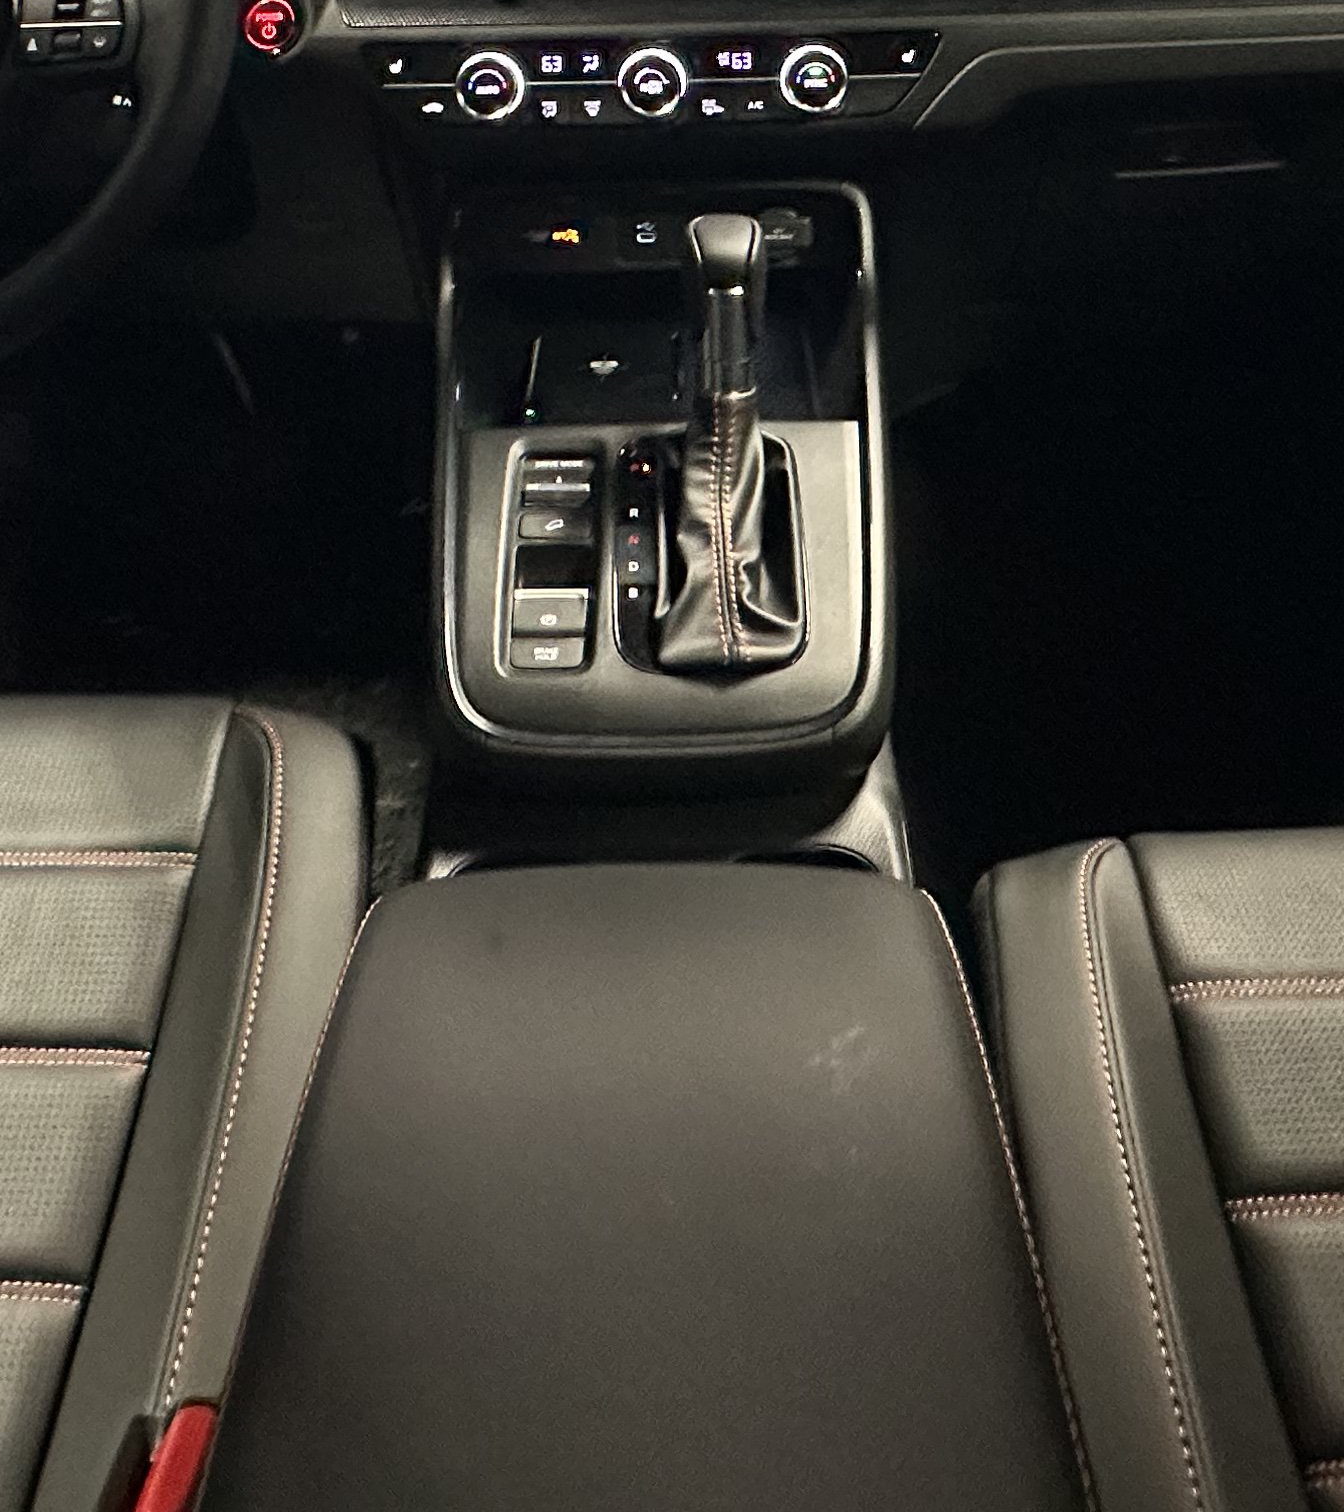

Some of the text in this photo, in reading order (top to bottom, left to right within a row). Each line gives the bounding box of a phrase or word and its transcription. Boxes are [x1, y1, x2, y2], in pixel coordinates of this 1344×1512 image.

[541, 55, 563, 73] 63
[731, 51, 752, 70] 63
[628, 560, 641, 572] D
